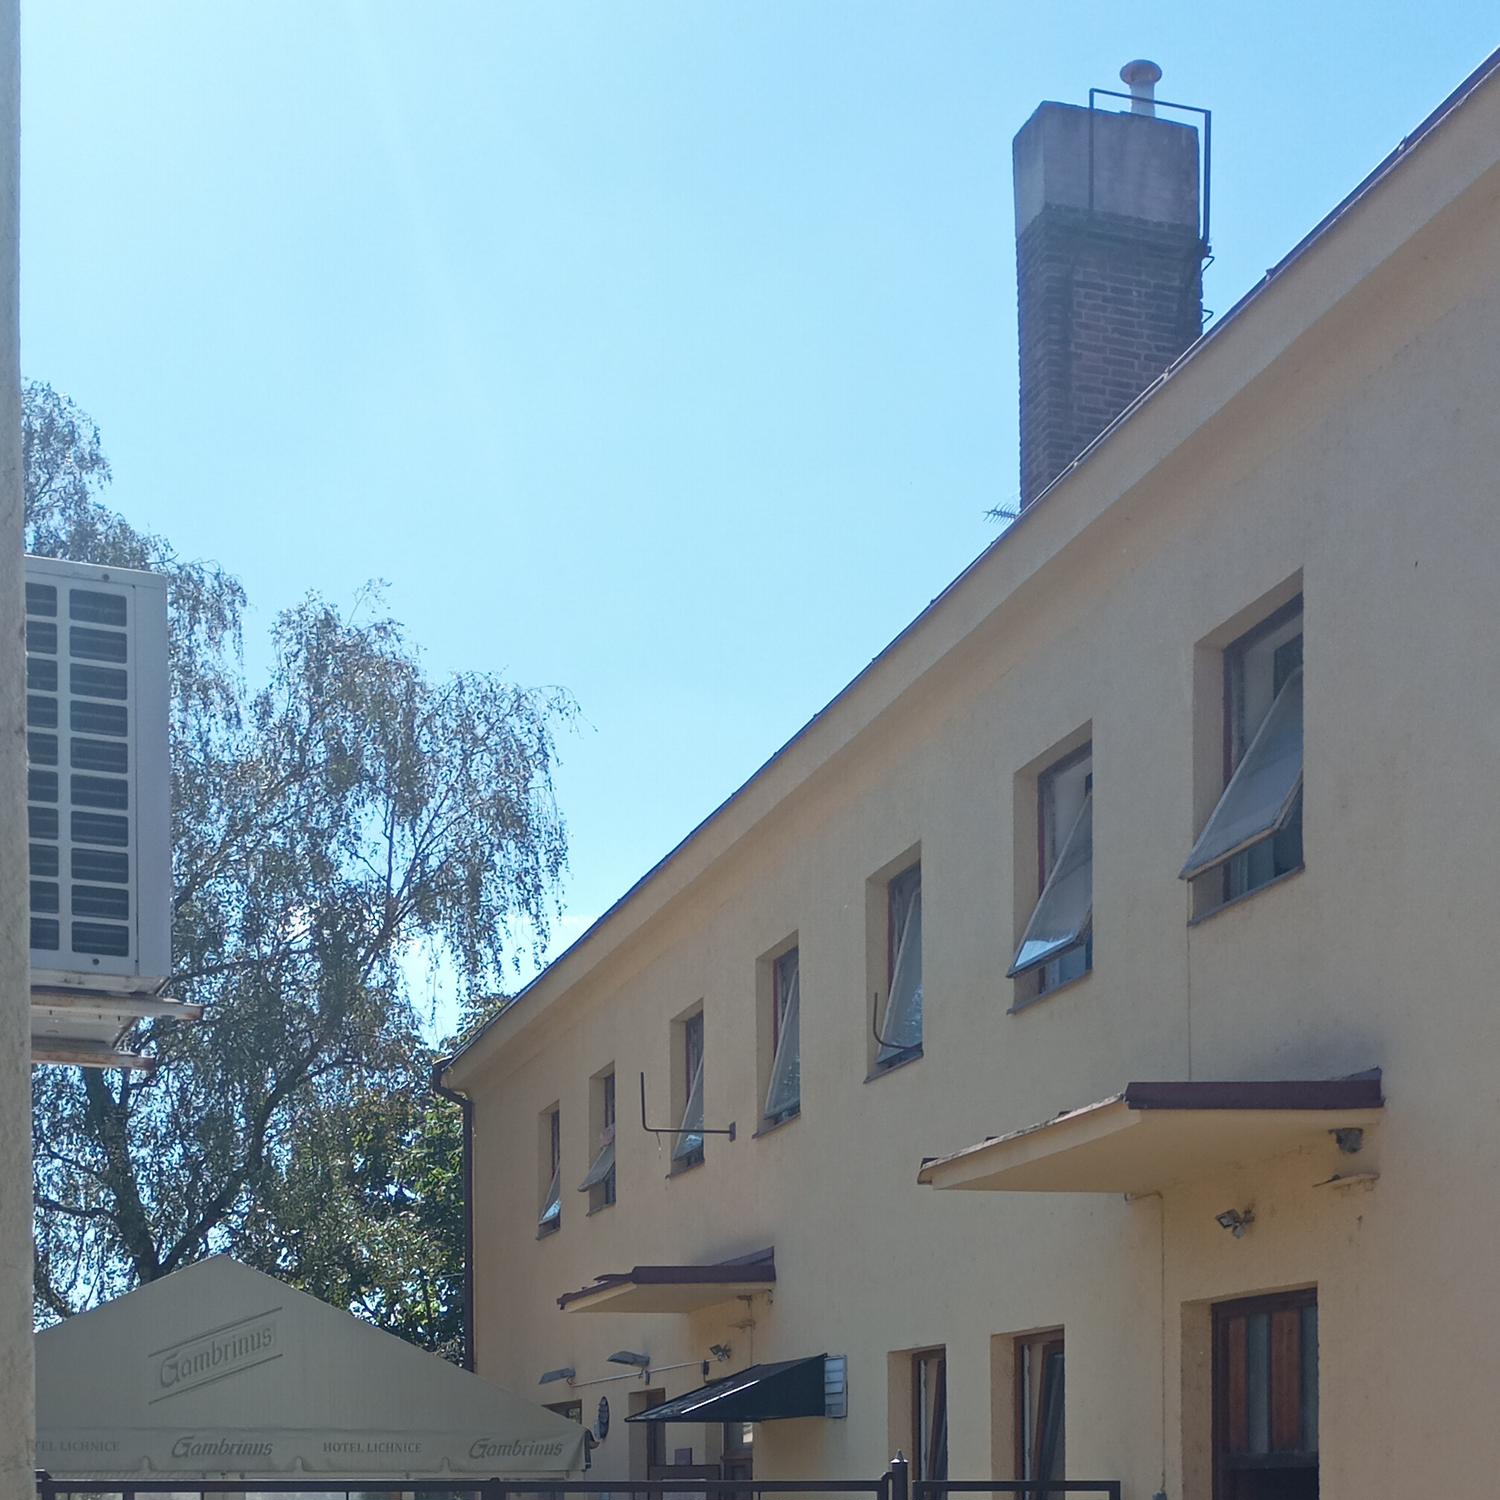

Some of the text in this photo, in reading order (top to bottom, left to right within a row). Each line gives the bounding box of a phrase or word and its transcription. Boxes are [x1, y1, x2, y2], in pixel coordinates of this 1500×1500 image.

[159, 1327, 274, 1389] Gambrinus
[171, 1435, 274, 1459] Gambrinus
[323, 1442, 422, 1453] HOTEL LICHNICE
[468, 1437, 564, 1459] Gambrinus
